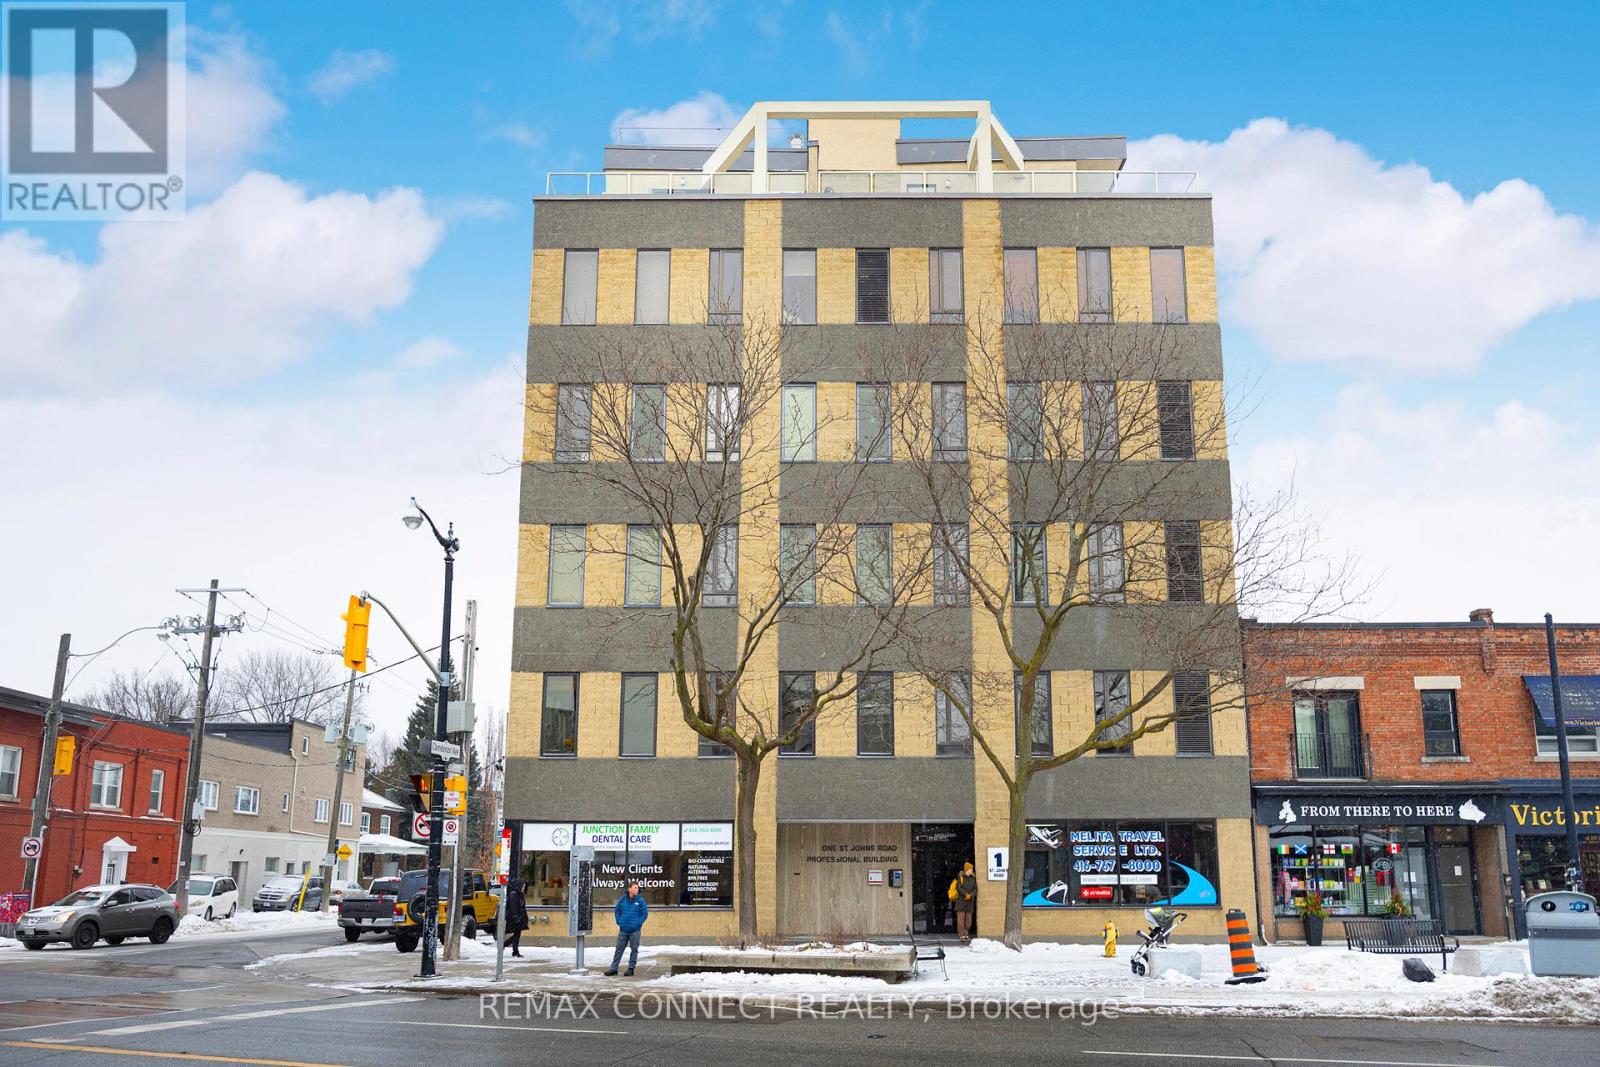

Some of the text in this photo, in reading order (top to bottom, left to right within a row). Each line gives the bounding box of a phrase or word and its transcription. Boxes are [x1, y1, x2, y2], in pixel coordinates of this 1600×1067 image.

[1300, 805, 1454, 817] FROM THERE TO HERE
[582, 825, 660, 834] JUNCTION FAMILY
[592, 835, 652, 843] DENTAL CARE
[1070, 830, 1165, 842] MELITA TRAVEL
[822, 844, 837, 852] ONE
[850, 844, 875, 852] JOHNS
[877, 844, 898, 852] ROAD
[1134, 844, 1162, 856] LTD.
[806, 855, 898, 863] PROFESSIONAL BUILDING
[994, 852, 1003, 867] 1
[602, 864, 663, 874] New Clients
[628, 878, 675, 888] elcome
